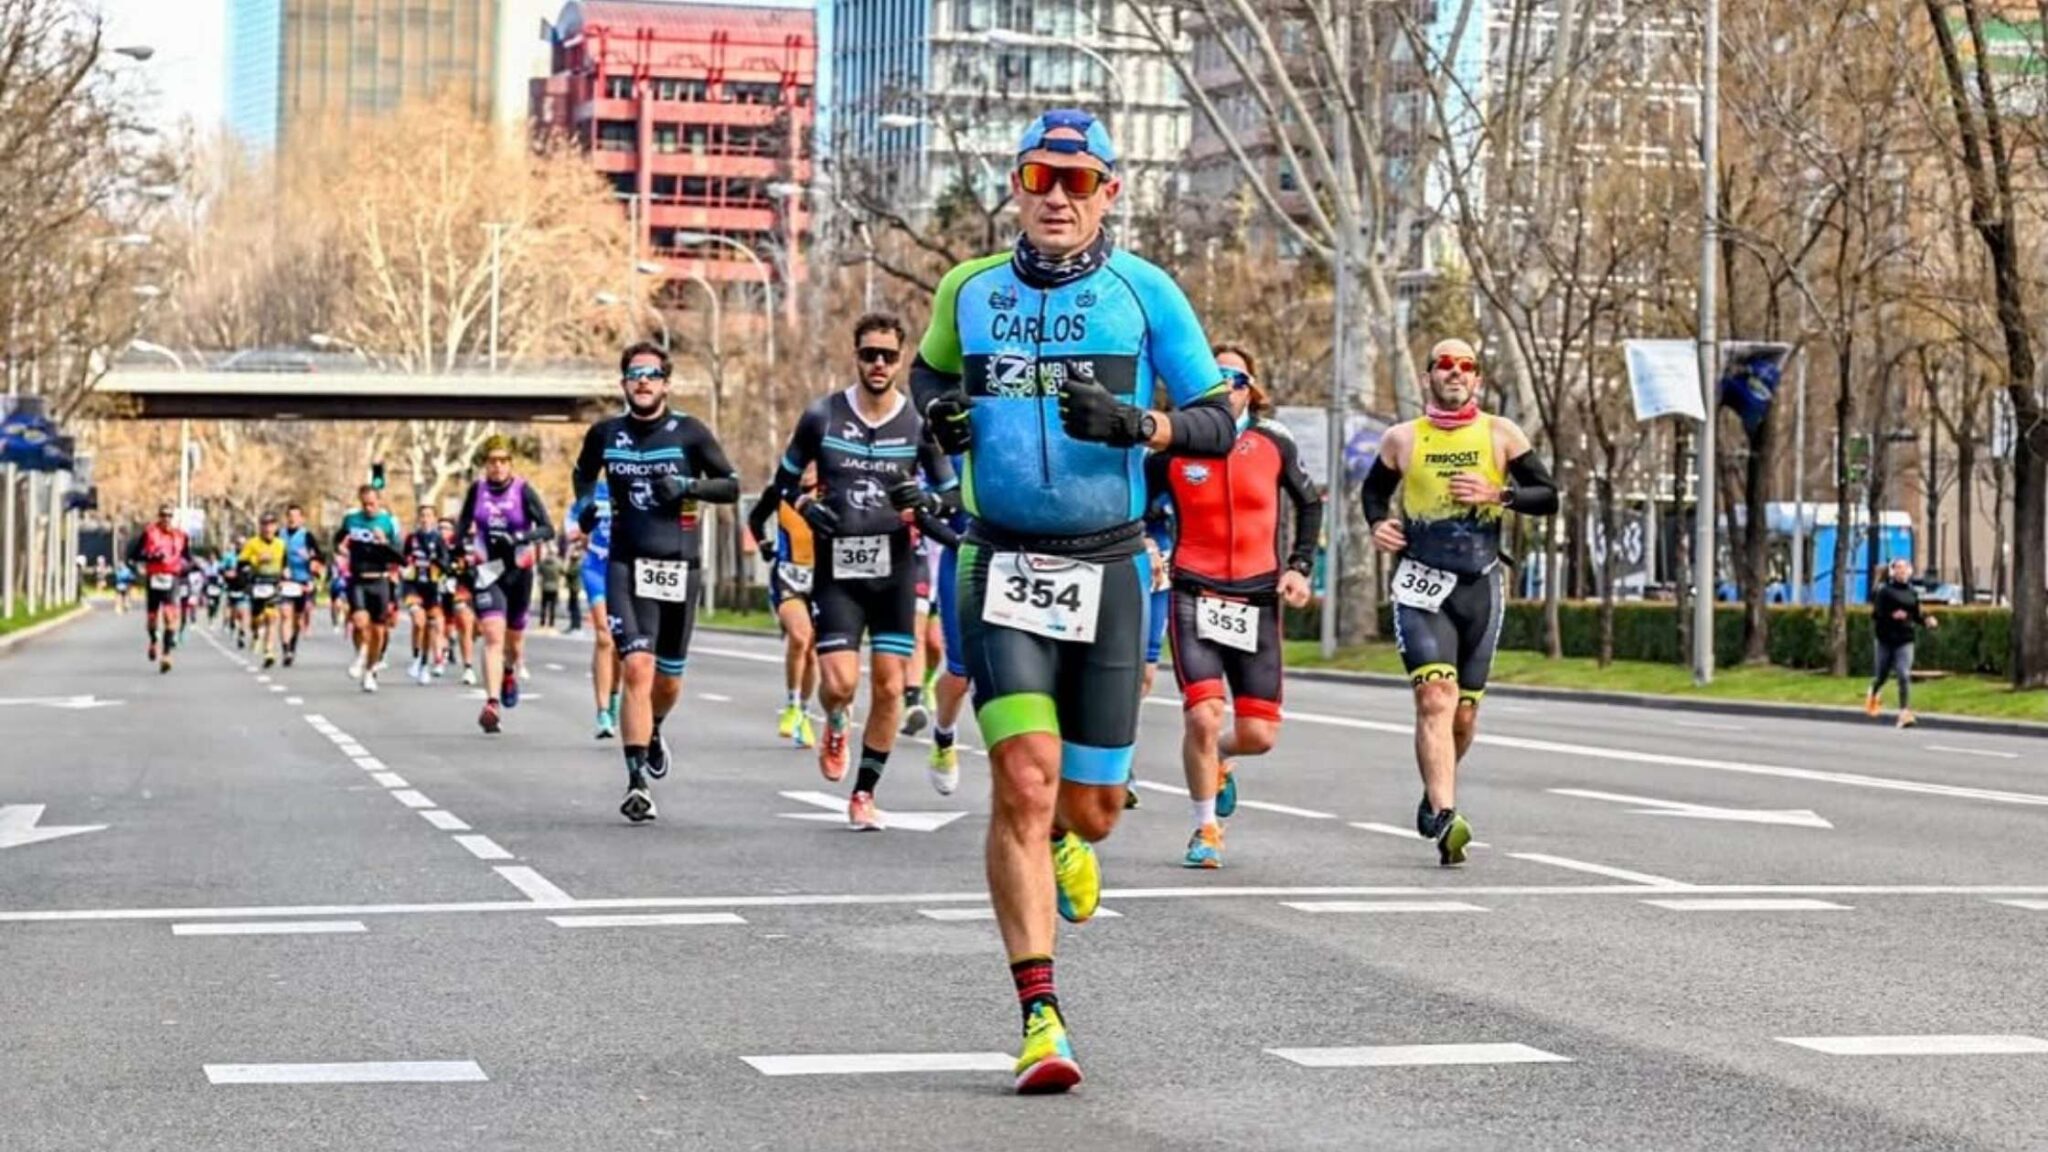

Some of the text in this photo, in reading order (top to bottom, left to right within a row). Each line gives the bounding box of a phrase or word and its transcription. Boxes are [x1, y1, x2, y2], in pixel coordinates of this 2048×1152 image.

[992, 312, 1086, 344] CARLOS
[842, 548, 880, 564] 367
[643, 568, 679, 587] 365
[1401, 573, 1442, 597] 390
[1004, 576, 1081, 612] 354
[1207, 609, 1247, 634] 353
